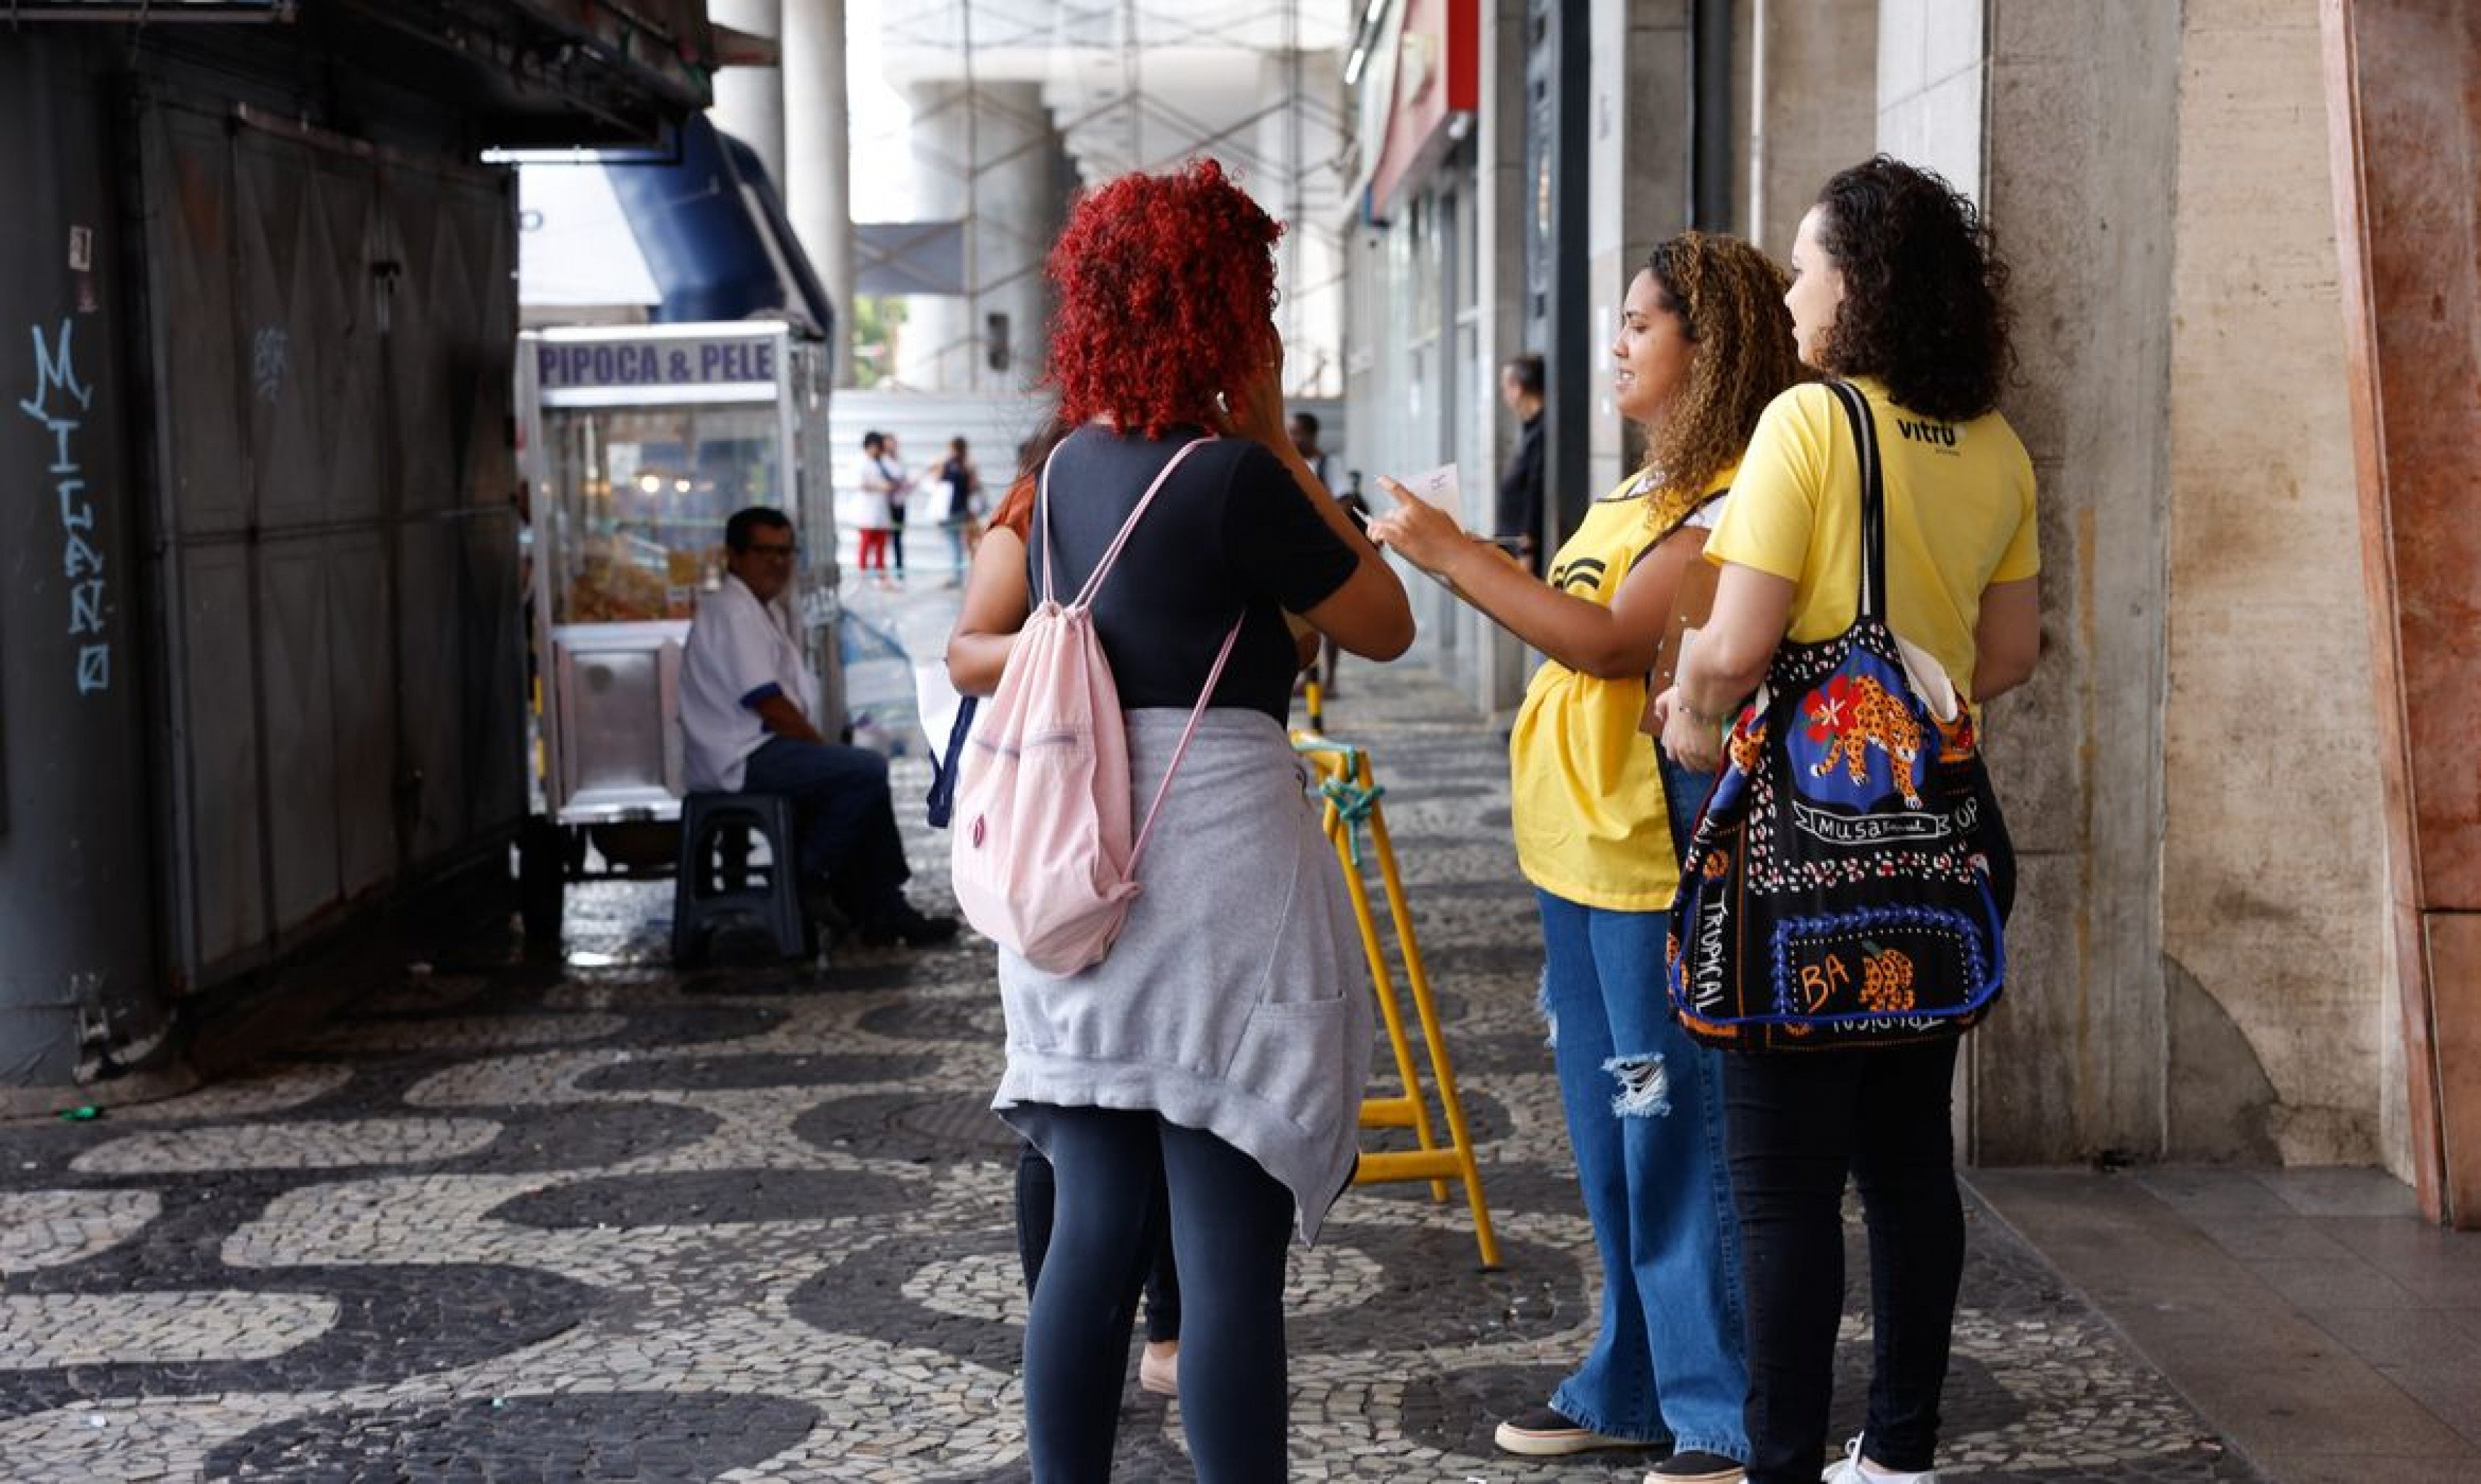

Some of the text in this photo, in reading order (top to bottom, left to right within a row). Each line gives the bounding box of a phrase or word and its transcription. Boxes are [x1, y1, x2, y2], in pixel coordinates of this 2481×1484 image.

[539, 342, 773, 385] PIPOCA & PELE
